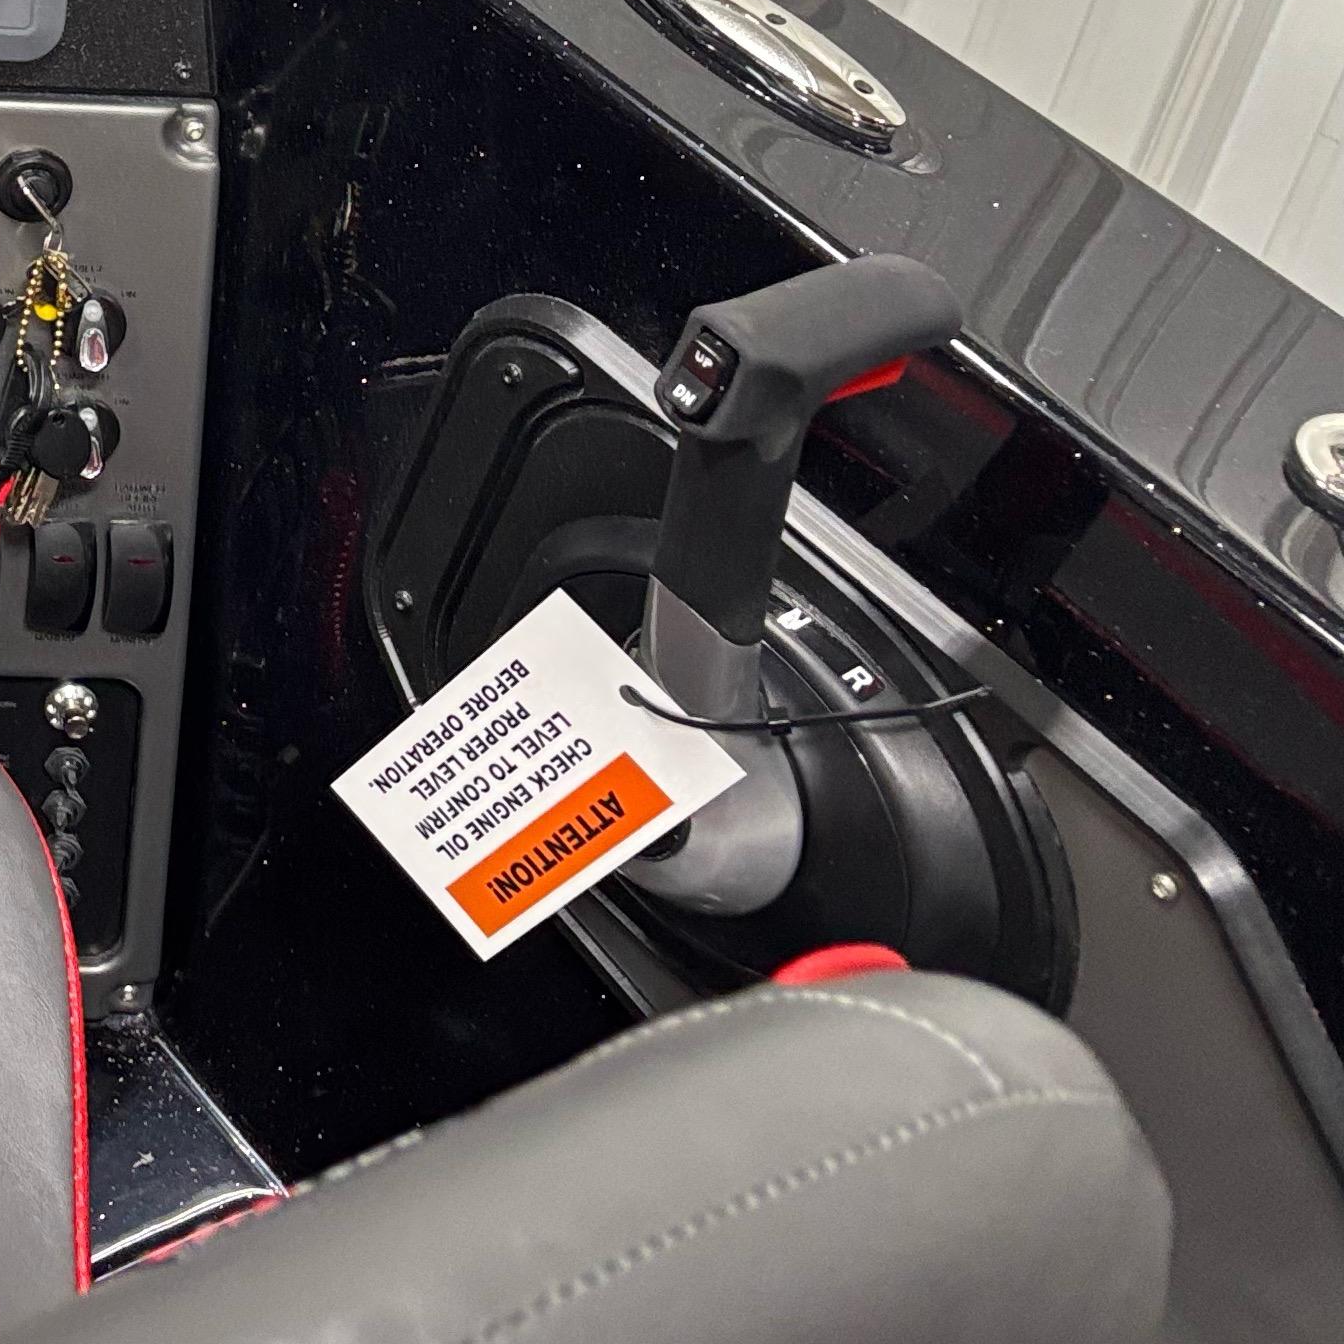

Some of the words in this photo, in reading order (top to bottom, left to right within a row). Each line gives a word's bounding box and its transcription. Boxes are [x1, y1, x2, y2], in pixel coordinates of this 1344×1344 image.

[694, 349, 714, 368] UP
[671, 384, 697, 408] DN
[776, 607, 812, 631] N
[464, 659, 530, 722] BEFORE
[842, 665, 874, 694] R
[368, 714, 464, 794] OPERATION.
[465, 701, 531, 762] PROPER
[512, 712, 572, 761] LEVEL
[409, 752, 466, 801] LEVEL
[489, 756, 517, 782] TO
[535, 738, 593, 792] CHECK
[415, 780, 490, 840] CONFIRM
[474, 784, 534, 842] ENGINE
[436, 832, 470, 861] OIL
[486, 790, 626, 904] ATTENTION!
